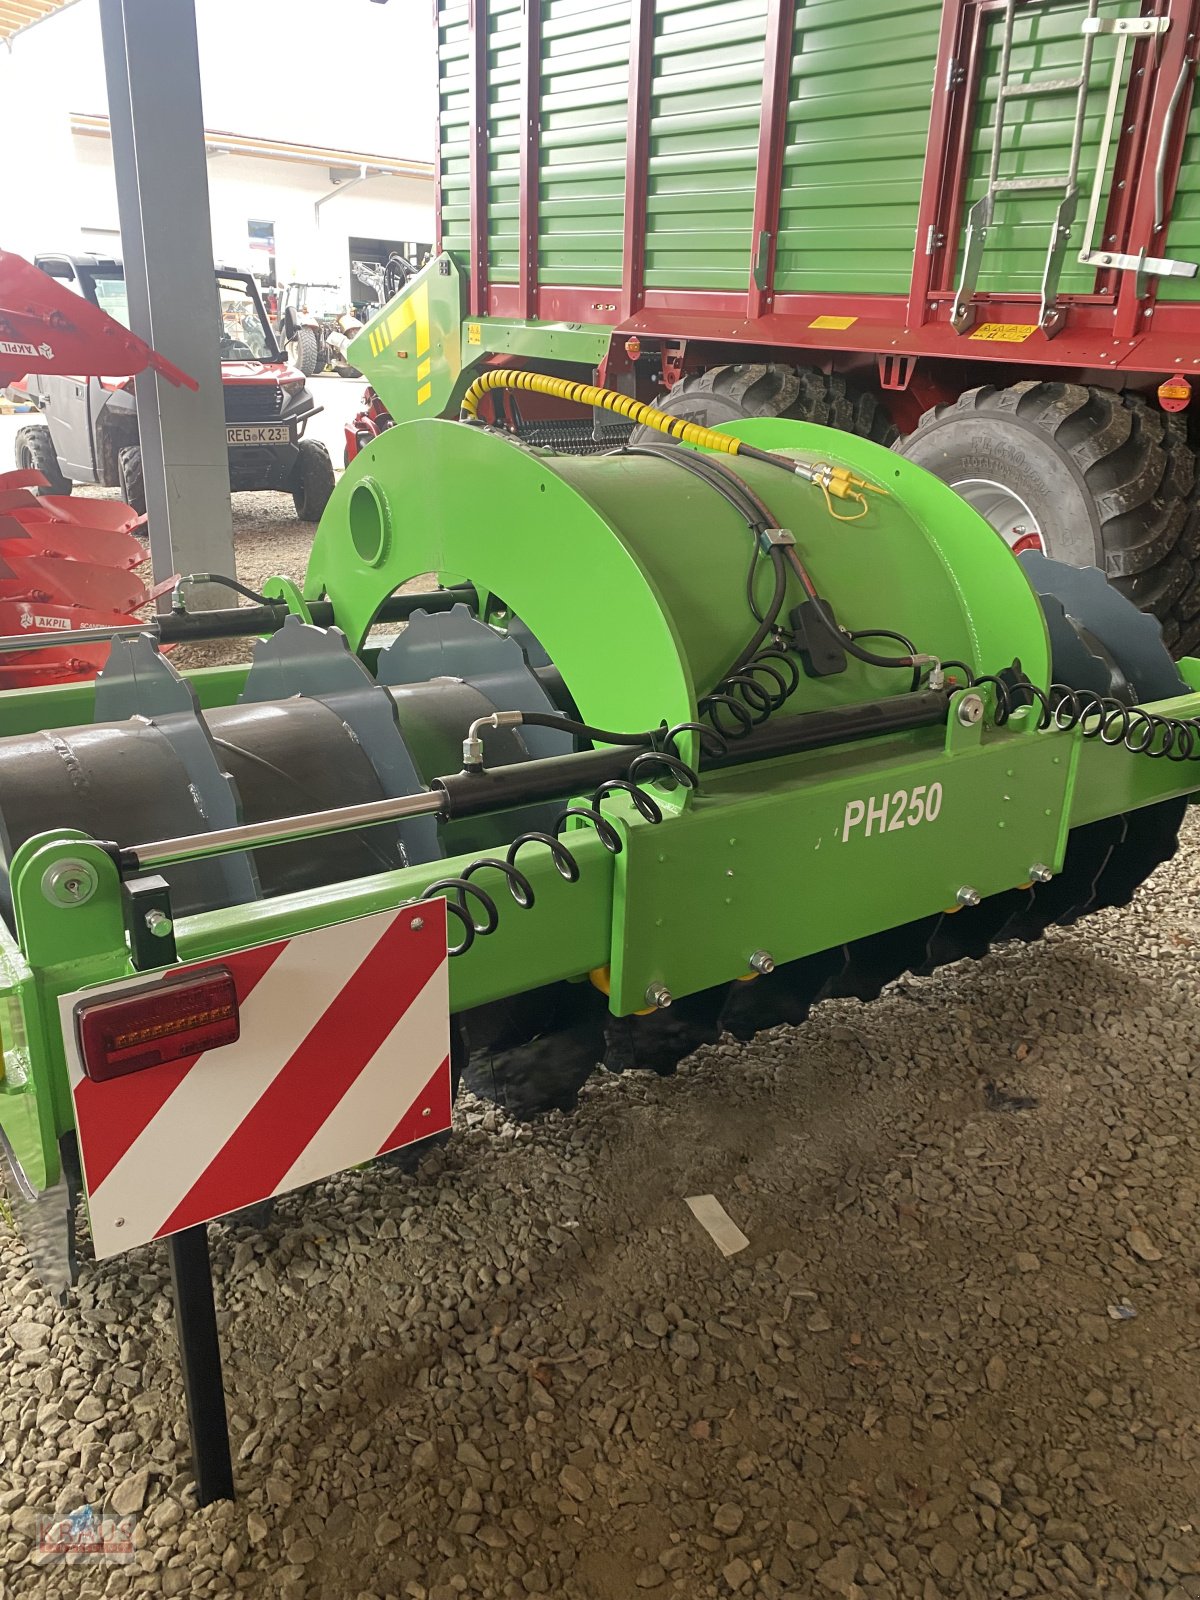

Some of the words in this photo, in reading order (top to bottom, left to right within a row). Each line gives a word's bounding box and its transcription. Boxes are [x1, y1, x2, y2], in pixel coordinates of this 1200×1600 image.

[1, 343, 33, 354] AKPIL
[228, 429, 251, 442] REG
[258, 429, 266, 441] K
[268, 428, 282, 441] 23
[38, 617, 67, 628] AKPIL
[841, 782, 943, 843] PH250
